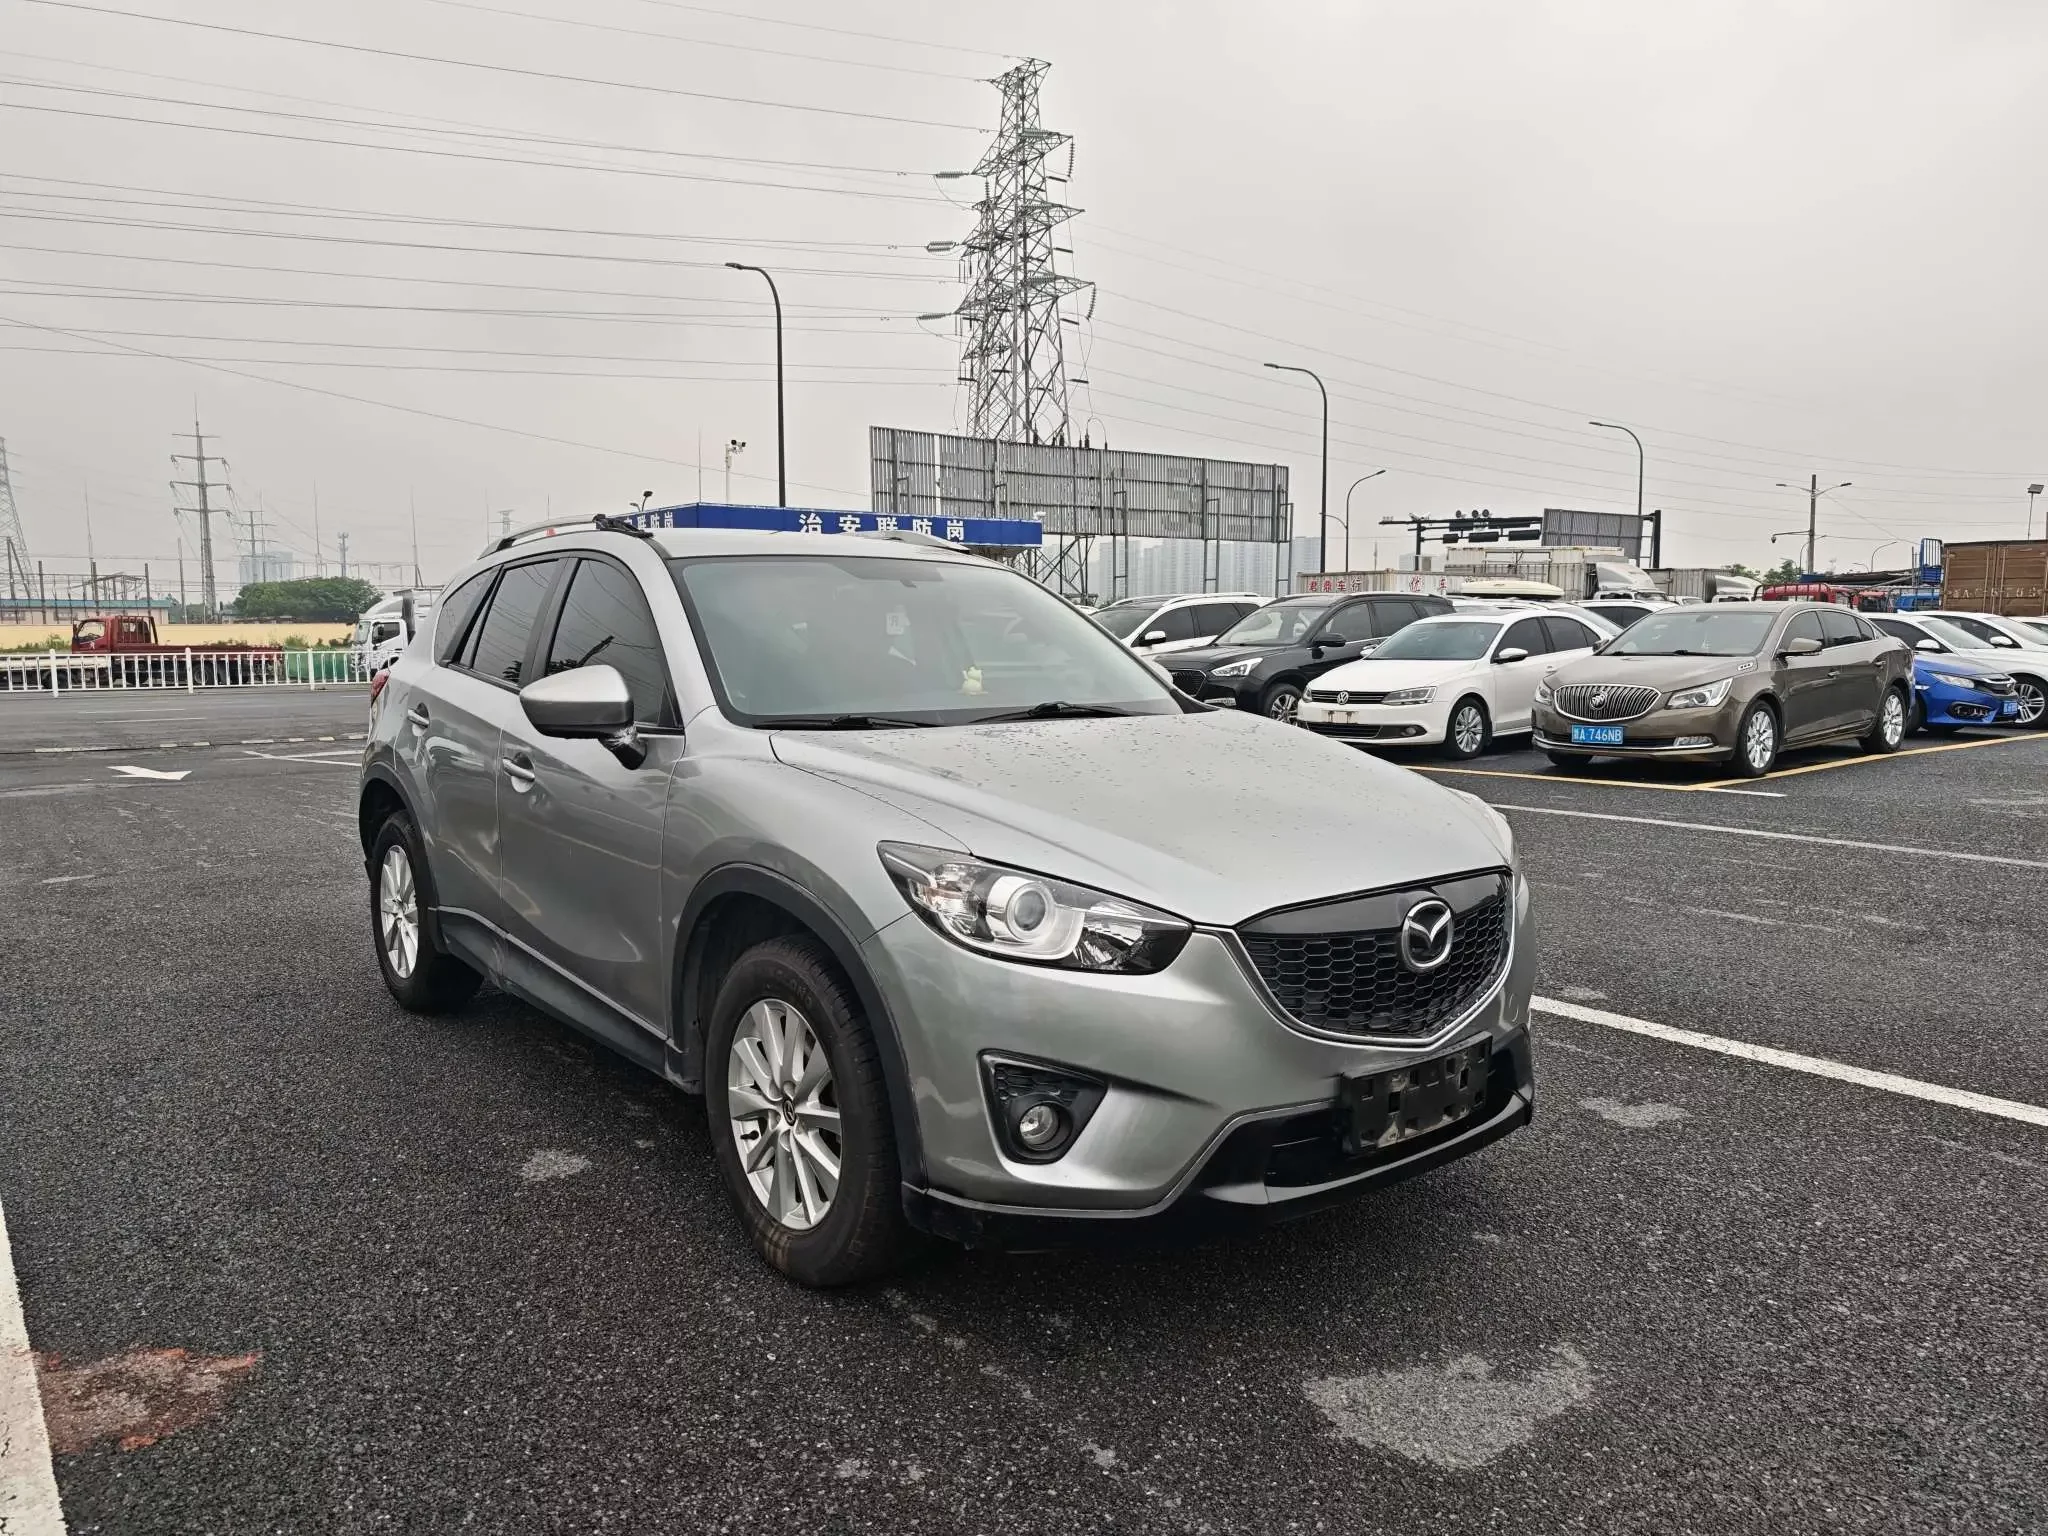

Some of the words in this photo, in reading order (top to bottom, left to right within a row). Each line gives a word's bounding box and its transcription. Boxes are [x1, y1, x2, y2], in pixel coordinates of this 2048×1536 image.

[798, 512, 965, 542] 治安联防岗
